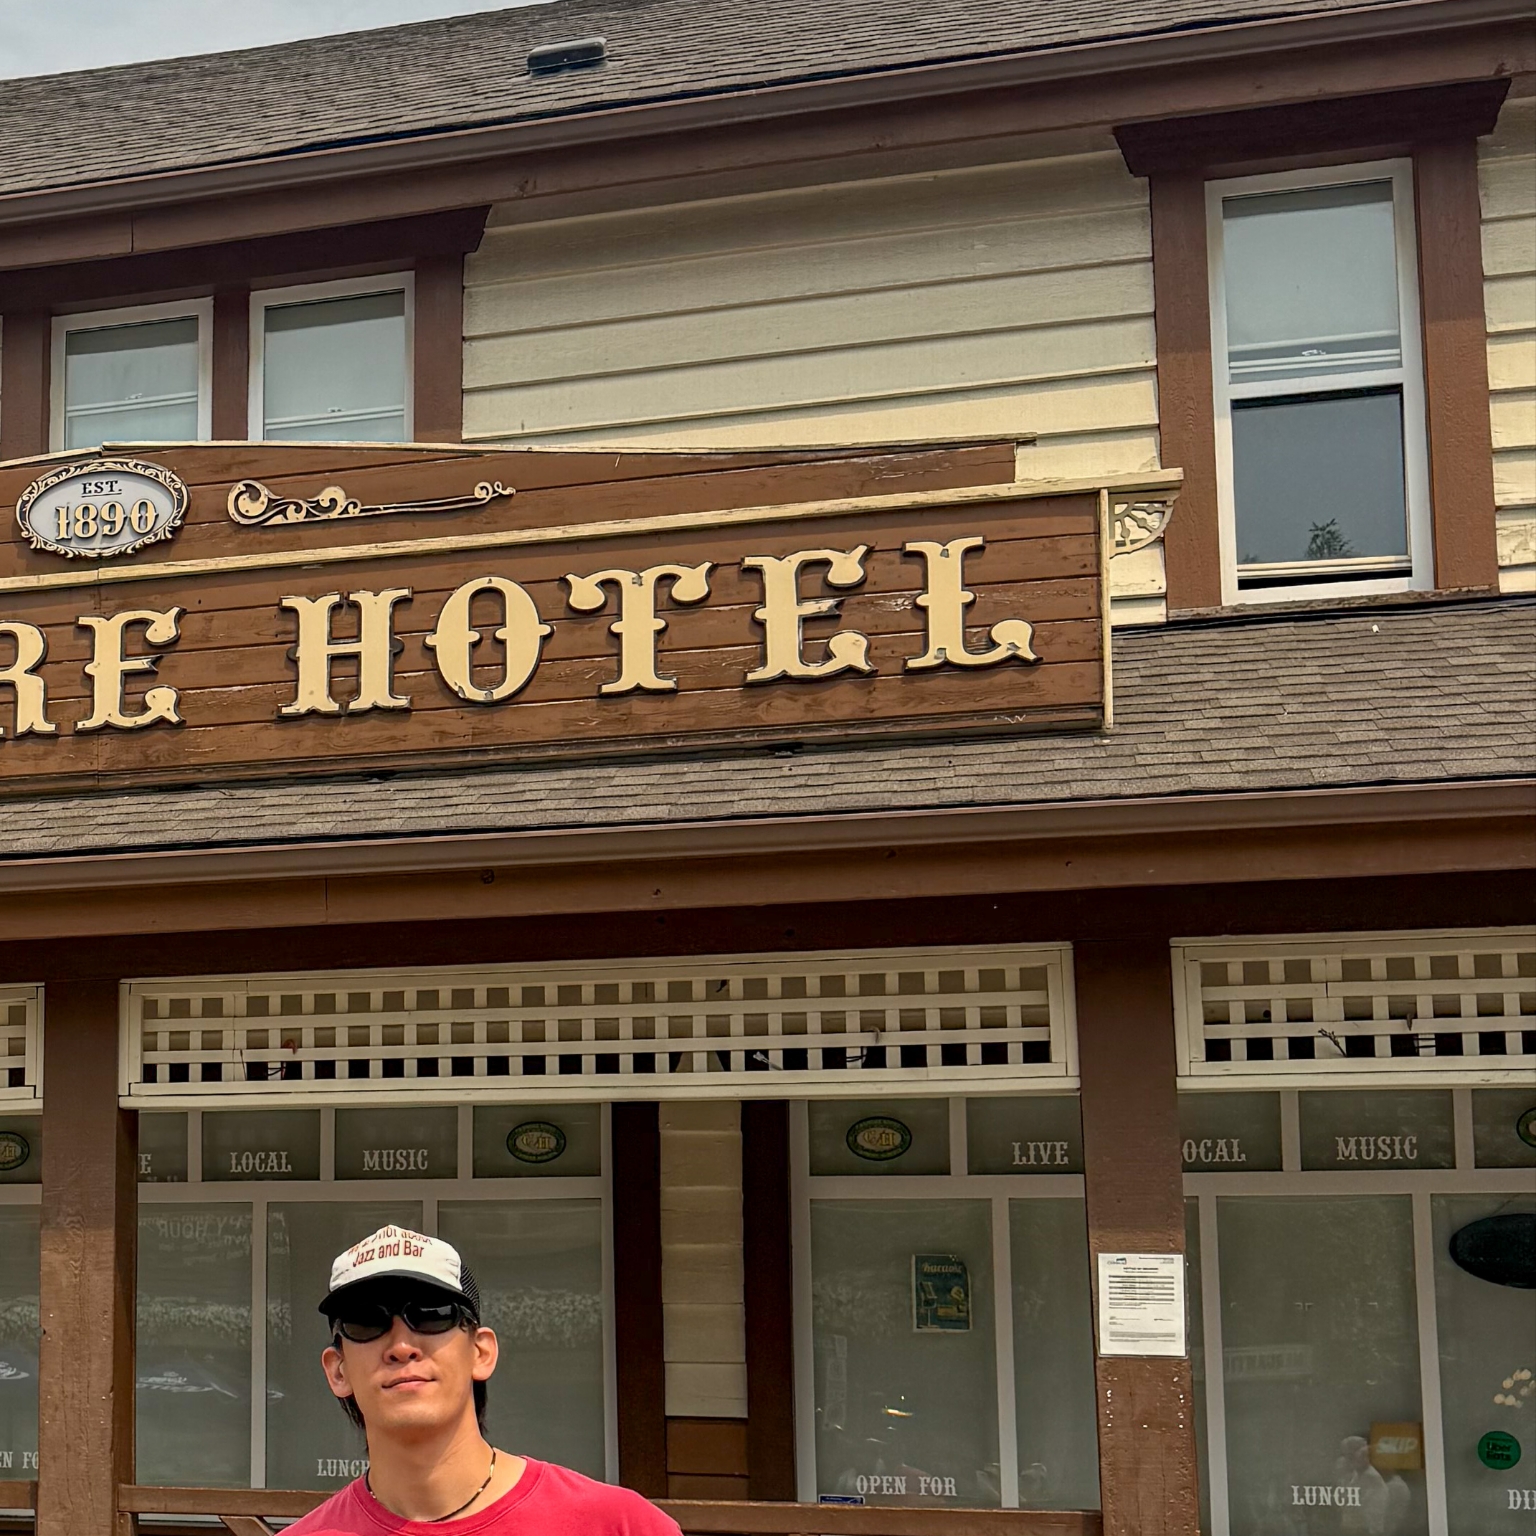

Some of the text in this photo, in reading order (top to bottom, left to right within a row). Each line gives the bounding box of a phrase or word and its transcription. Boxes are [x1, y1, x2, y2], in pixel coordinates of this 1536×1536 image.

[81, 480, 122, 495] EST.
[55, 498, 159, 540] 1890
[277, 535, 1043, 717] HOTEL
[363, 1149, 428, 1171] MUSIC
[1012, 1141, 1069, 1165] LIVE
[1180, 1138, 1247, 1163] OCAL
[1335, 1136, 1418, 1160] MUSIC
[230, 1151, 292, 1173] LOCAL
[352, 1248, 375, 1268] Jazz
[378, 1240, 401, 1259] and
[404, 1240, 424, 1258] Bar
[856, 1475, 957, 1496] OPEN FOR
[1291, 1485, 1361, 1507] LUNCH
